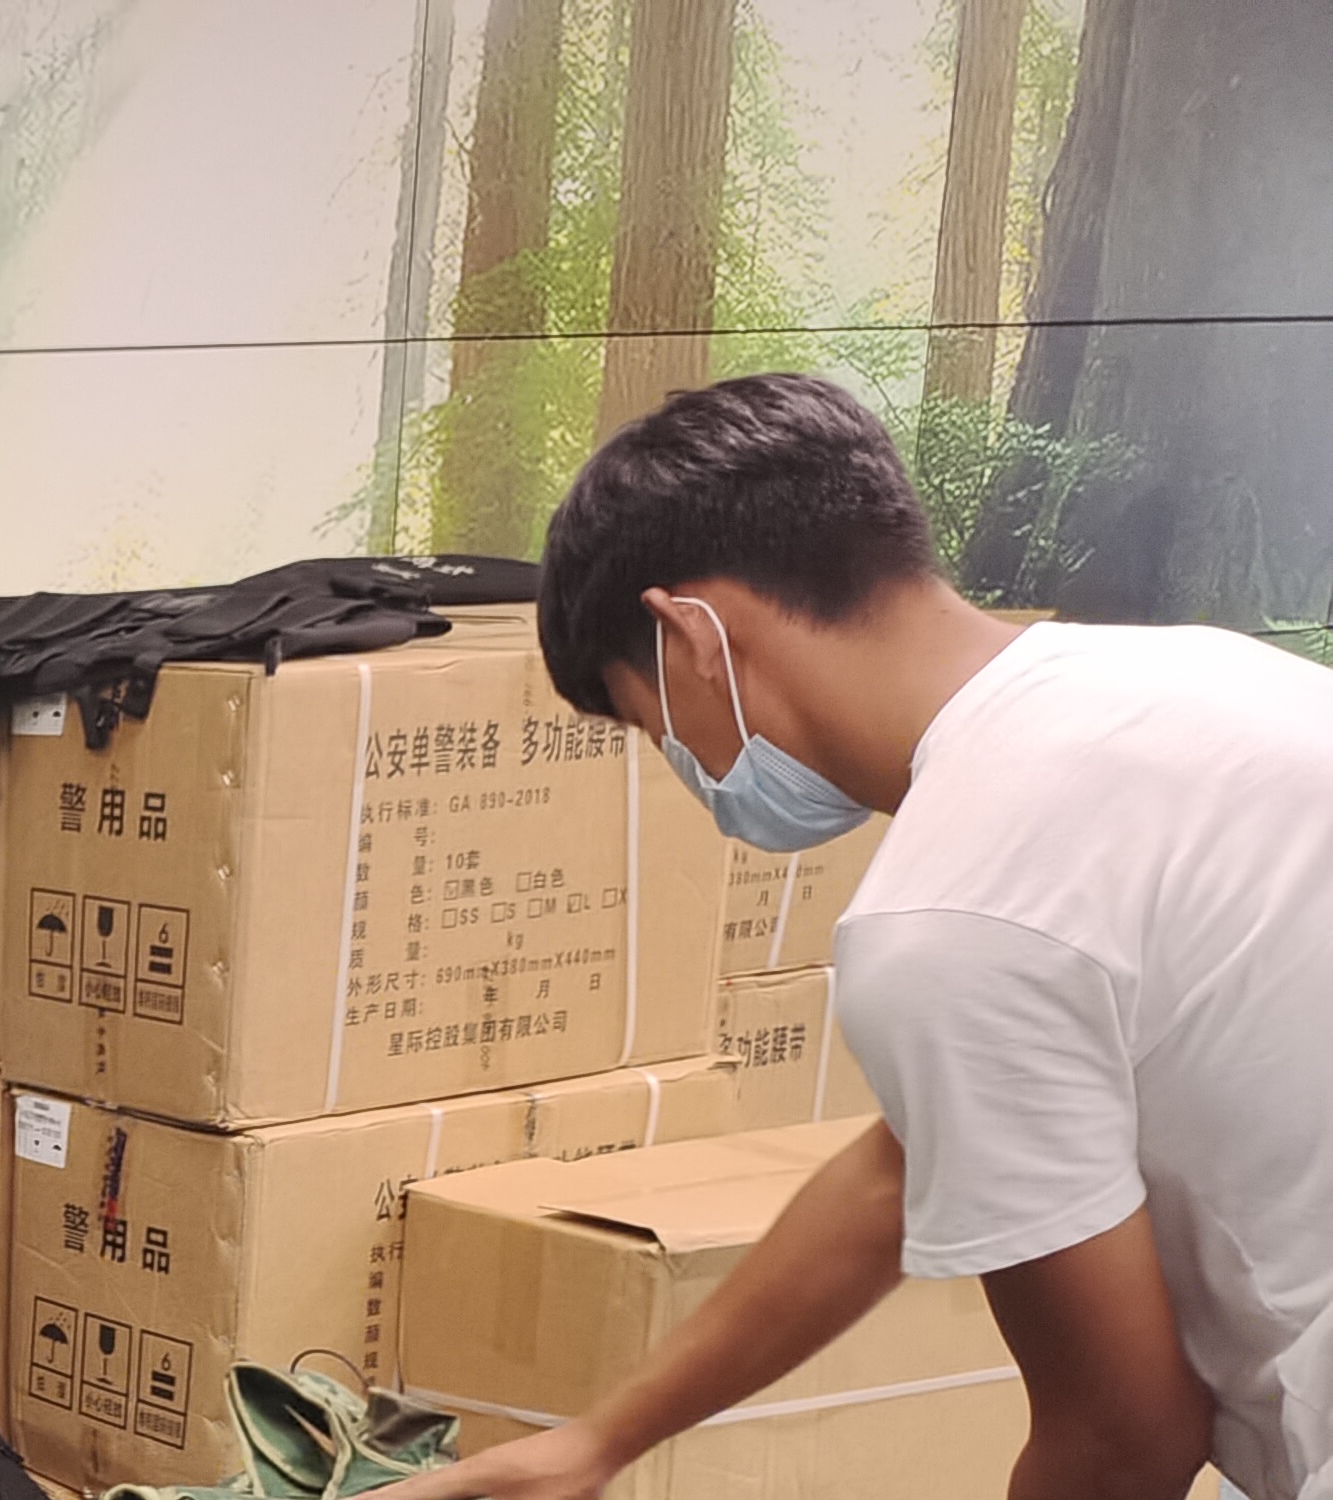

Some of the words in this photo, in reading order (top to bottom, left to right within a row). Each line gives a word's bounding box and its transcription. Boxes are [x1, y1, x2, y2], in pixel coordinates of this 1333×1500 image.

[366, 719, 500, 778] 公安单警装备
[59, 782, 168, 842] 警用品
[448, 795, 471, 814] GA
[480, 786, 551, 811] 890-2018
[445, 850, 481, 870] 10套
[728, 864, 824, 886] 380mmX40mm
[802, 884, 813, 901] 日
[505, 931, 525, 950] kg
[535, 979, 551, 999] 月
[588, 972, 602, 991] 日
[386, 1008, 569, 1058] 星际控股集团有限公司
[62, 1202, 172, 1276] 警用品
